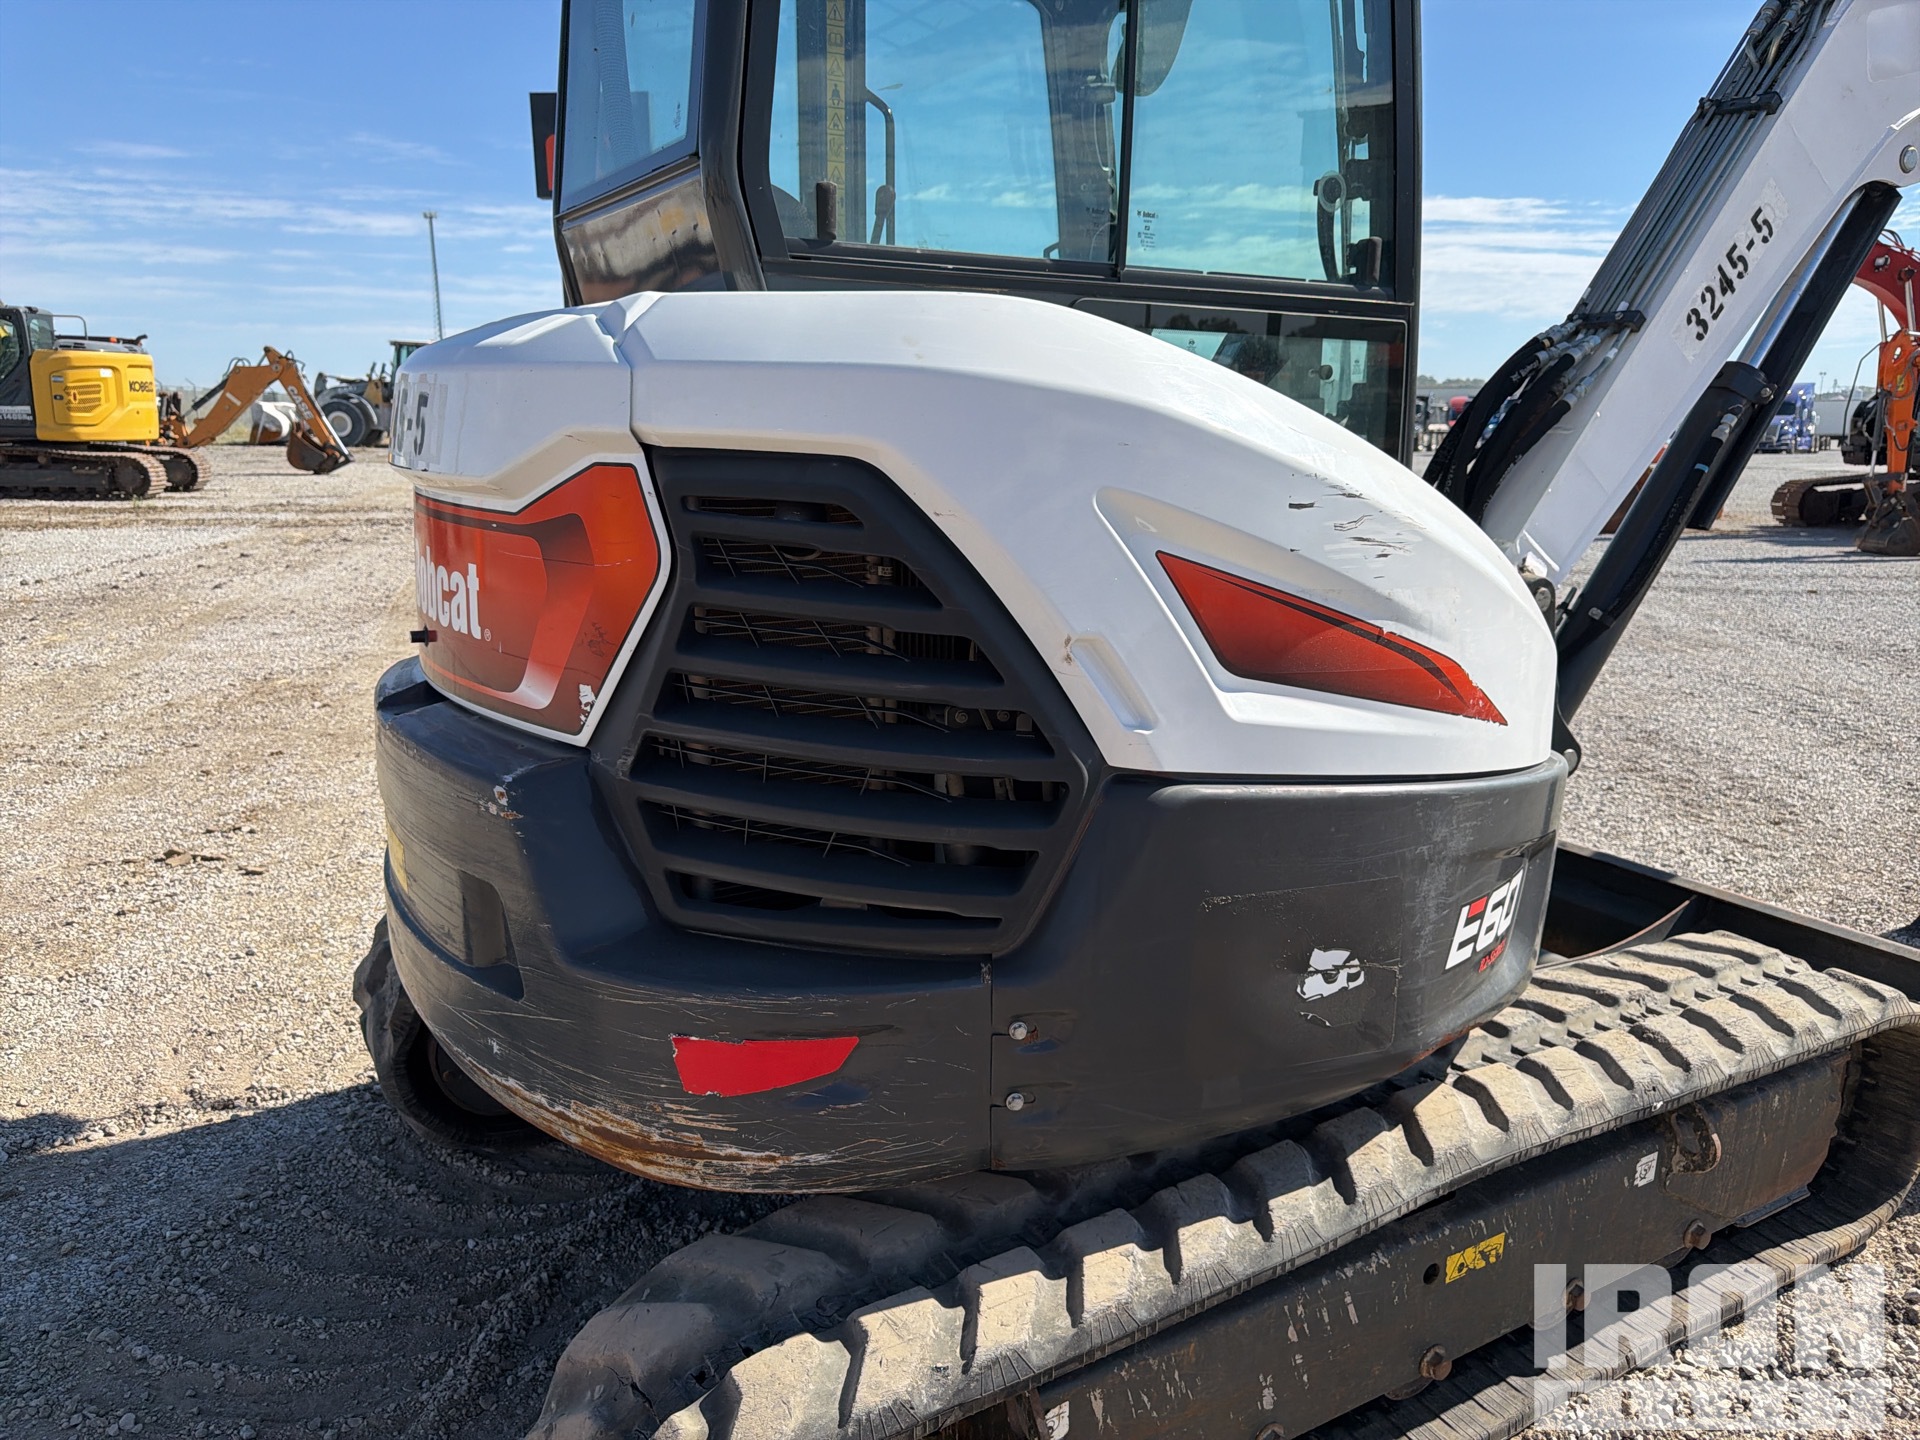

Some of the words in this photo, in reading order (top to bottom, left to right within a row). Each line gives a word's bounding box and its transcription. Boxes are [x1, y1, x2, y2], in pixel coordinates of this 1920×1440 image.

[1686, 206, 1774, 341] 3245-5
[287, 385, 314, 420] CASE
[1445, 868, 1524, 970] E60
